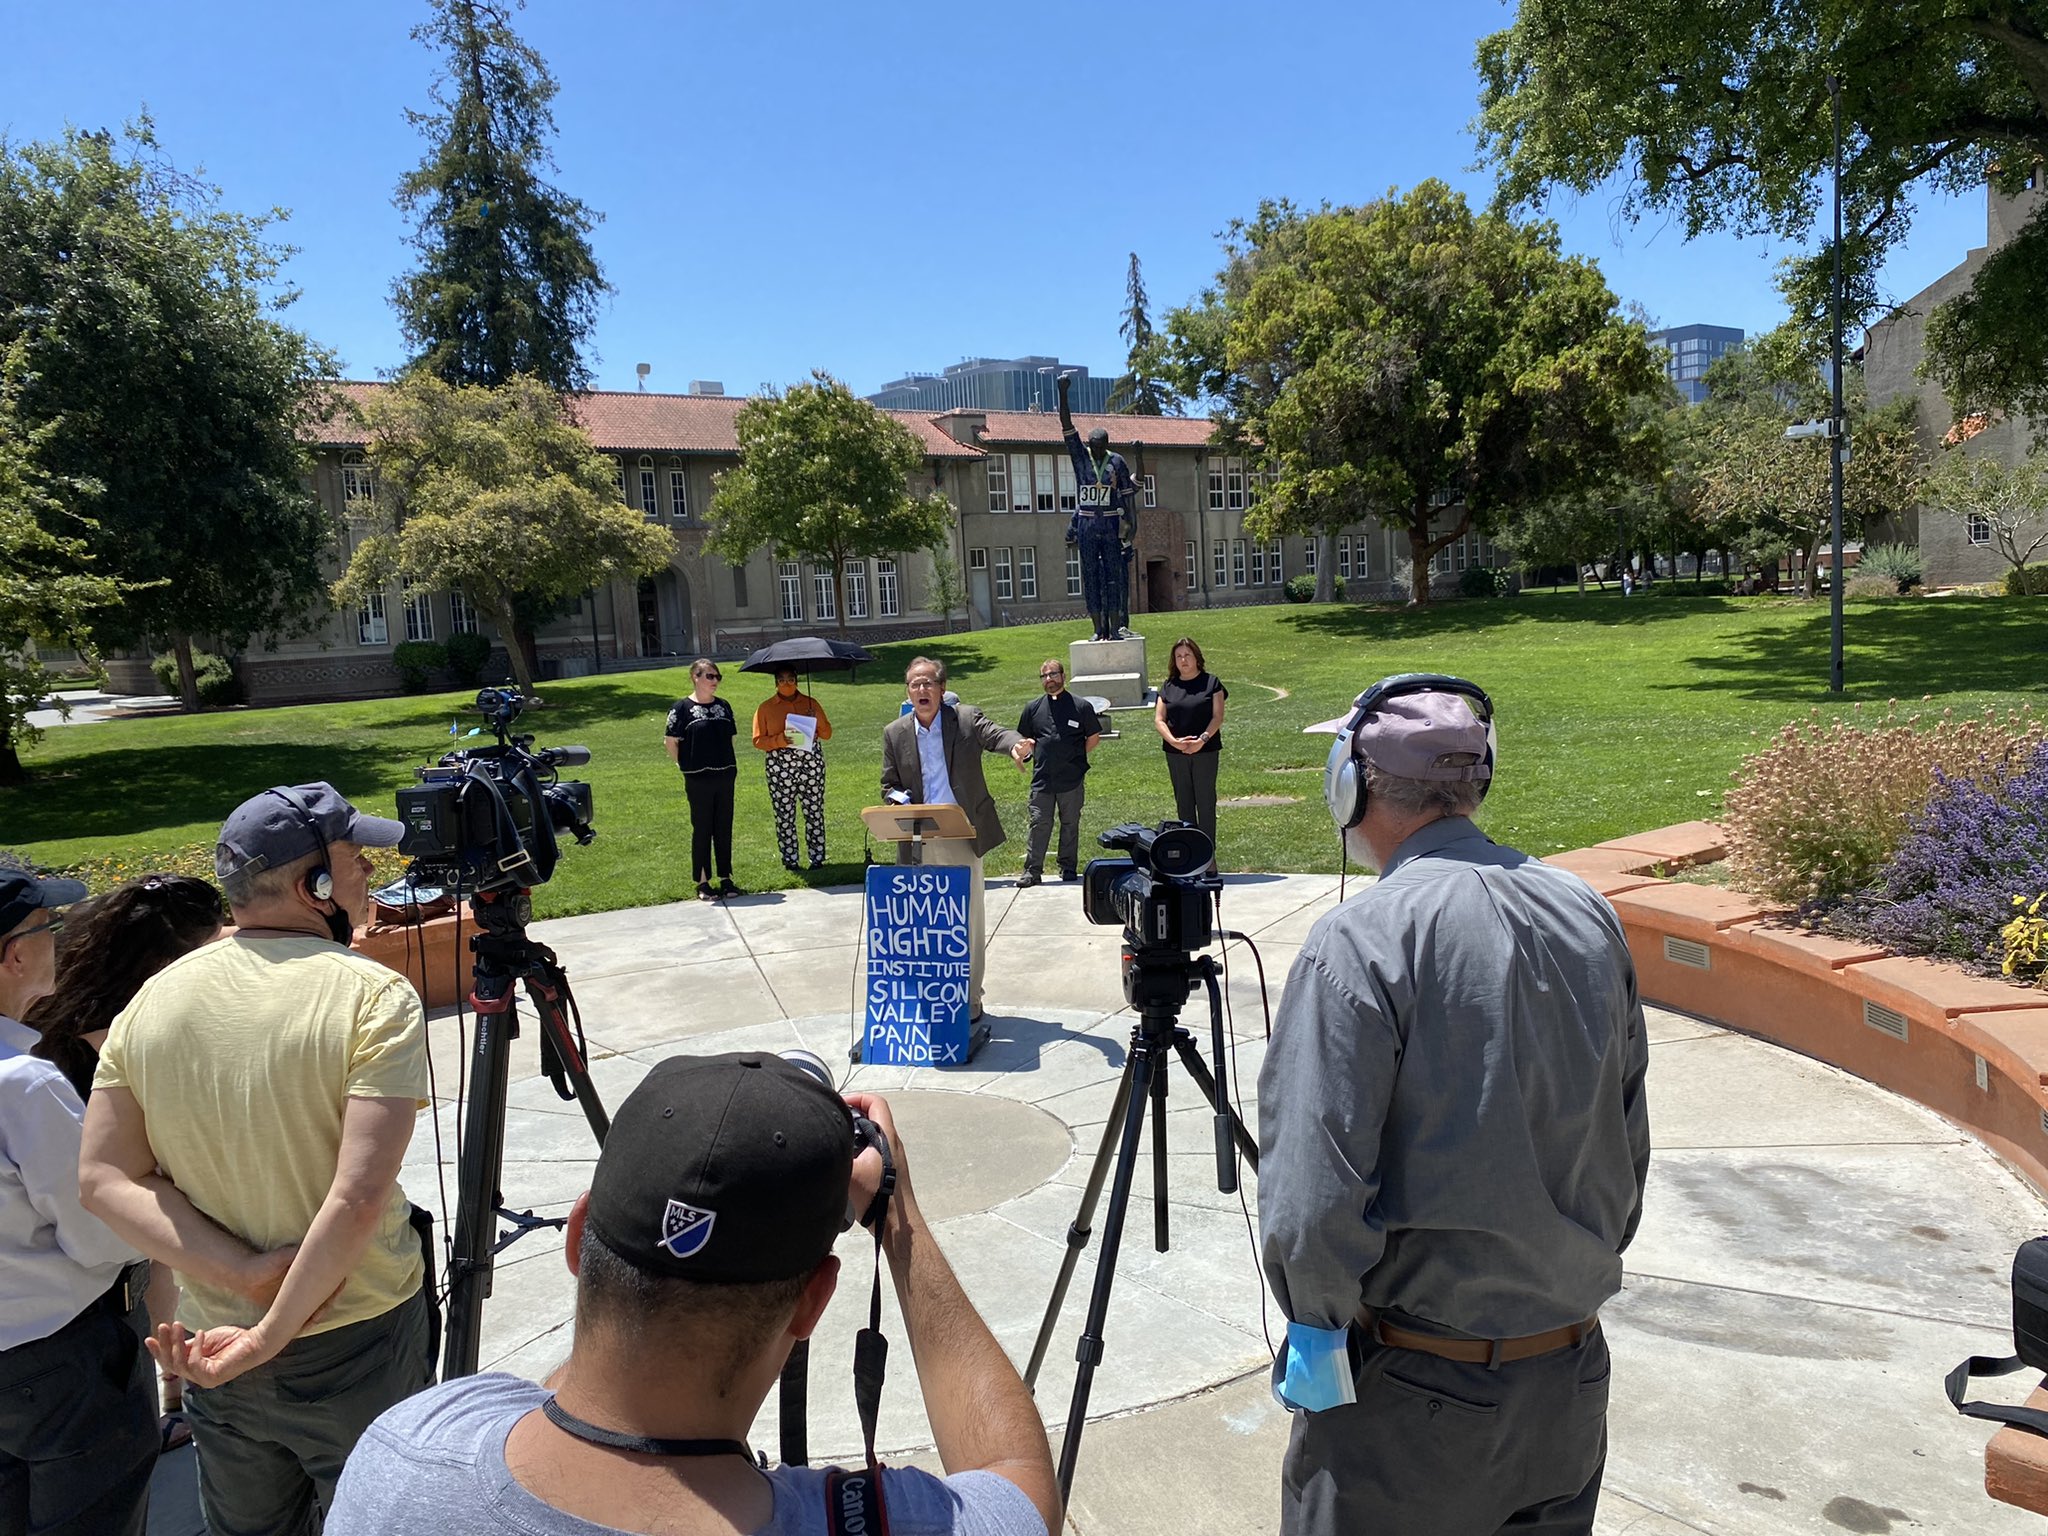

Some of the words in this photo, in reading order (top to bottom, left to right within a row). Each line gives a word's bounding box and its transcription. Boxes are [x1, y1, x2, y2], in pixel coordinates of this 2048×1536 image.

[1081, 486, 1109, 501] 307
[892, 874, 949, 894] SJSU
[870, 895, 966, 926] HUMAN
[869, 925, 968, 958] RIGHTS
[868, 959, 970, 977] INSTITUTE
[870, 979, 969, 1003] SILICON
[869, 1003, 963, 1024] VALLEY
[870, 1024, 931, 1046] PAIN
[889, 1043, 960, 1063] INDEX
[670, 1205, 697, 1222] MLS
